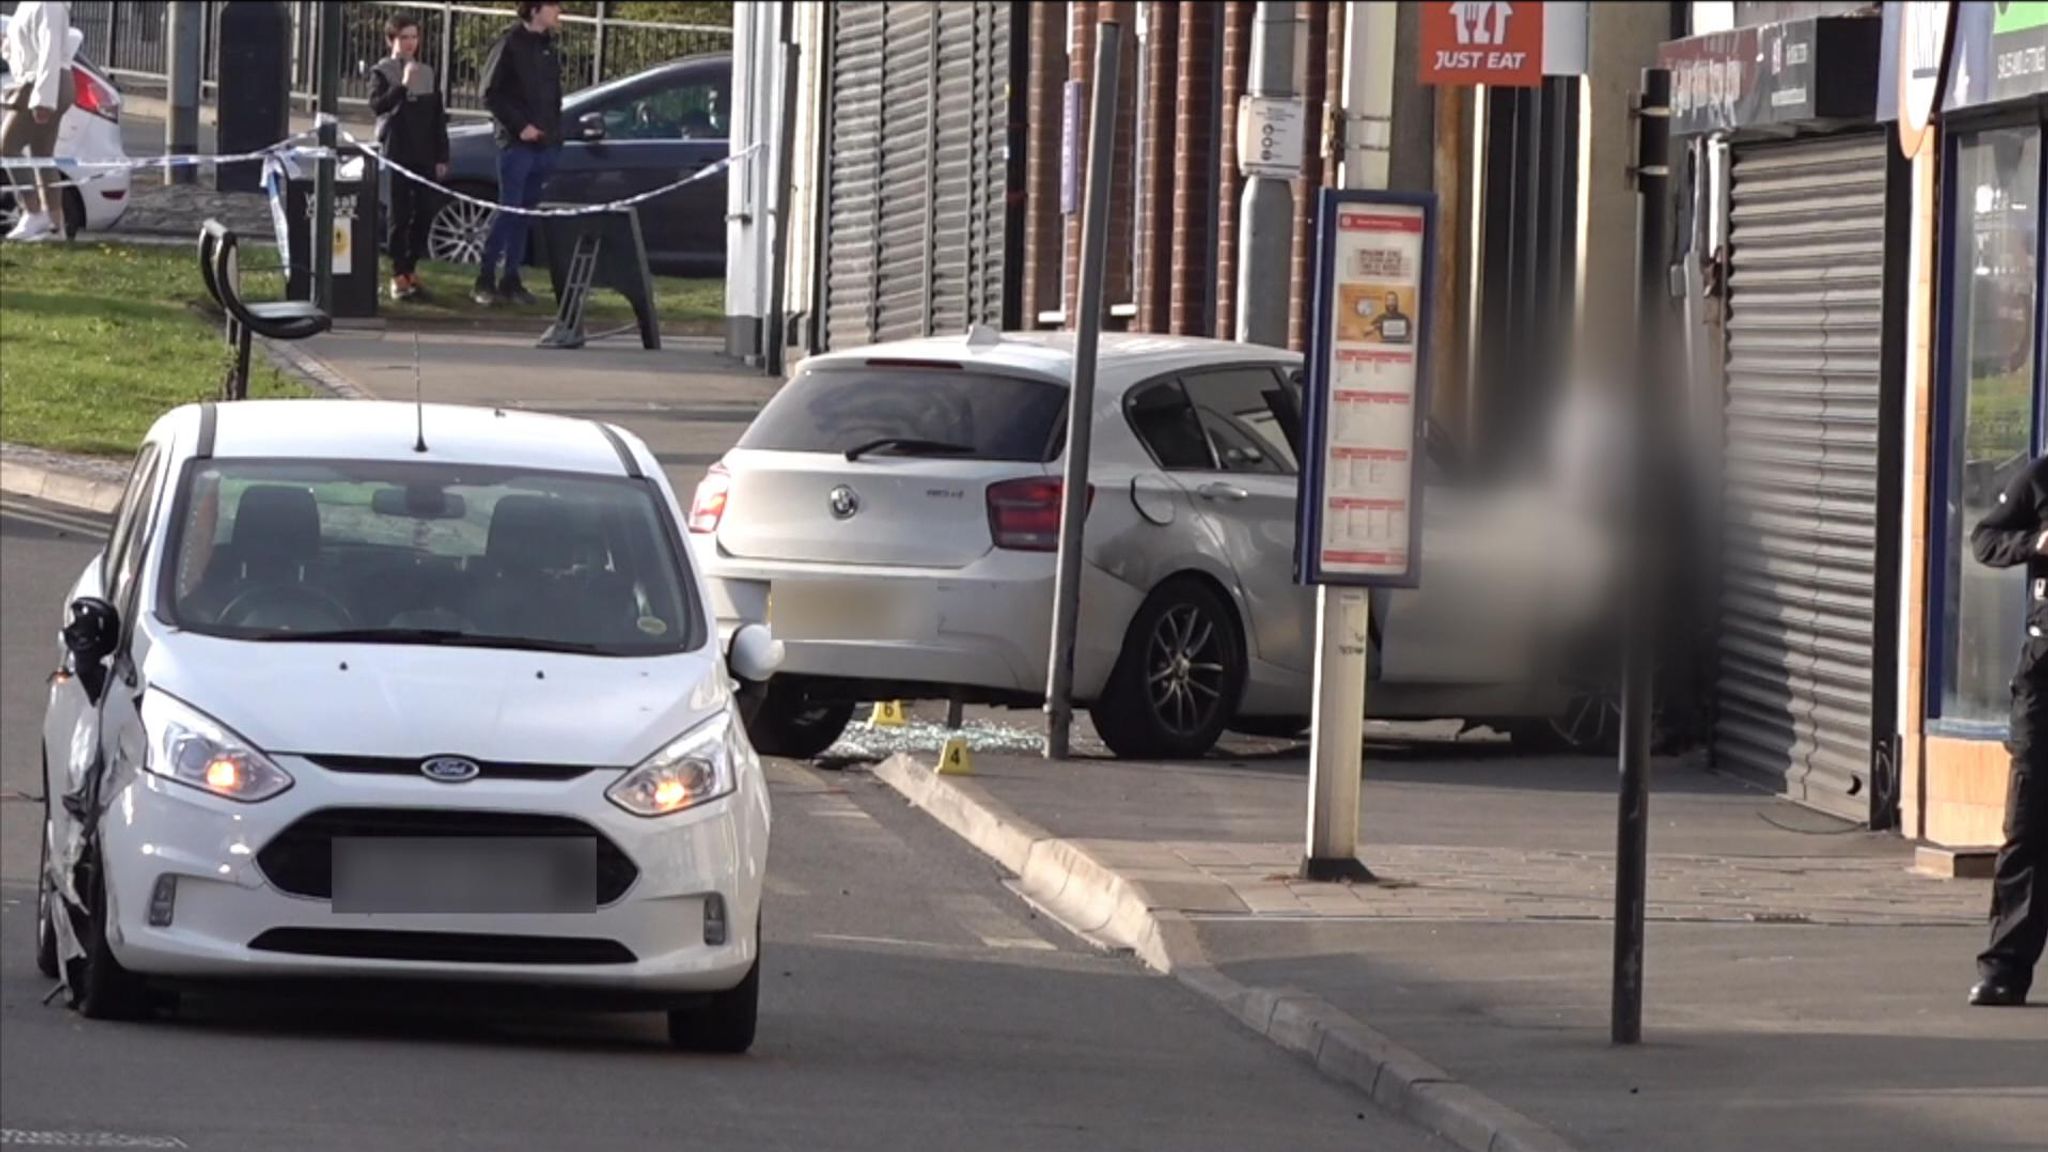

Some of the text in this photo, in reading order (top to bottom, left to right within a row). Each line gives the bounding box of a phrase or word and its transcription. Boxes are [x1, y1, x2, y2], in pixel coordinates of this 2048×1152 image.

[1433, 51, 1526, 70] JUST EAT
[950, 747, 960, 765] 4
[433, 760, 466, 774] Ford
